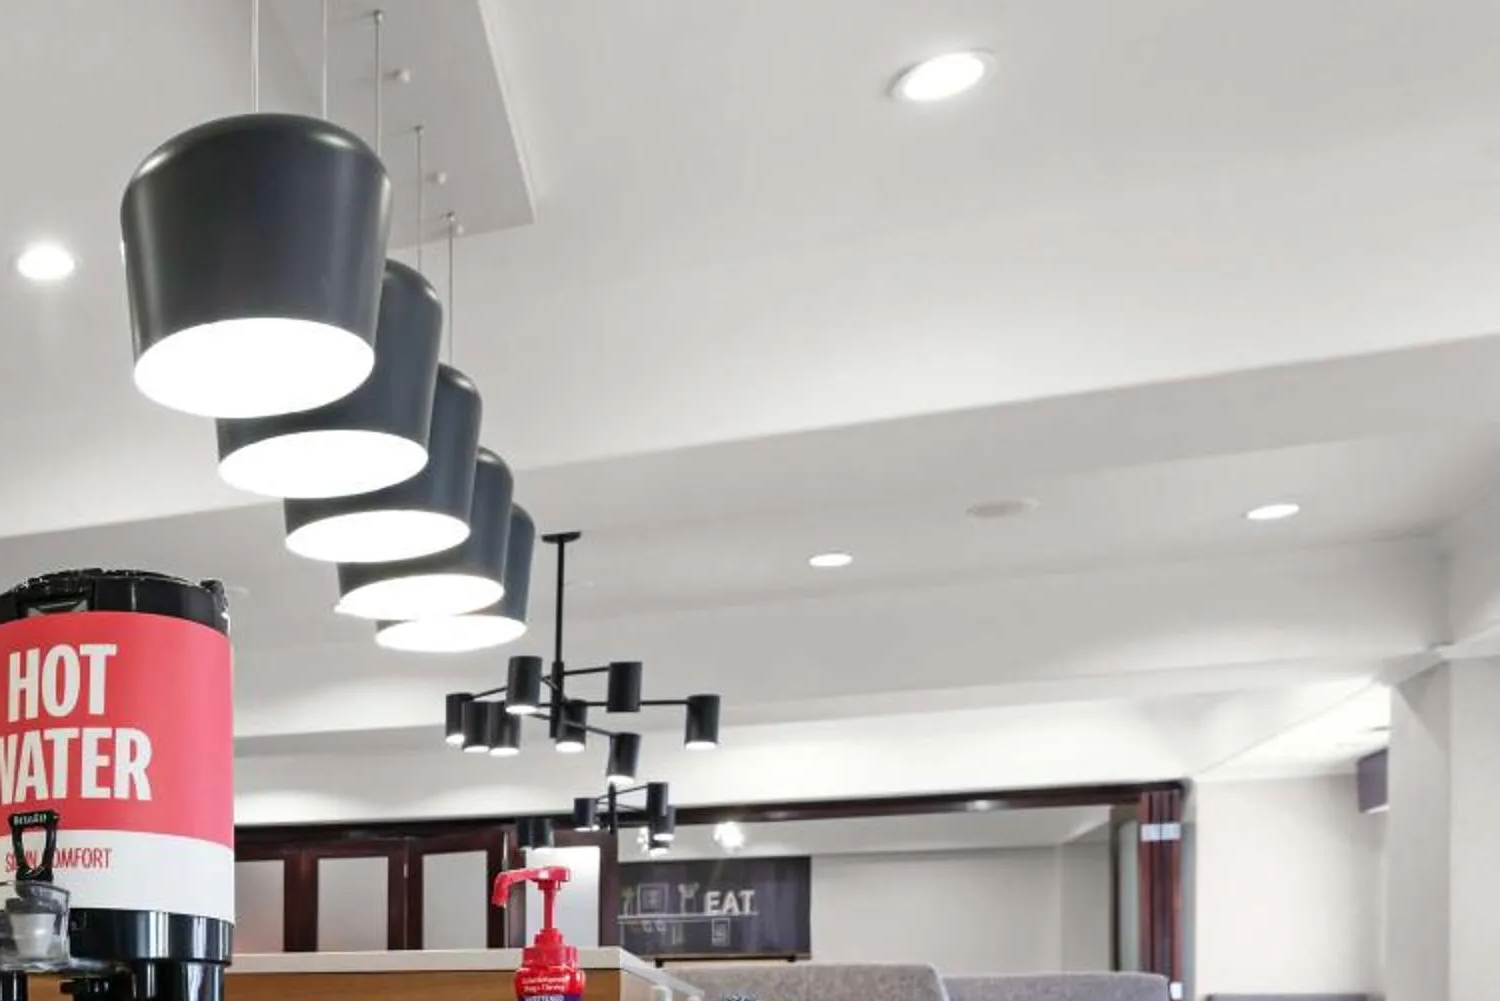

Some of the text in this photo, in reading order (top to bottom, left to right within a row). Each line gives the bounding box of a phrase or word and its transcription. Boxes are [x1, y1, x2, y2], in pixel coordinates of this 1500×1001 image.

[8, 643, 117, 722] HOT
[52, 846, 112, 870] OMFORT
[704, 889, 755, 916] EAT
